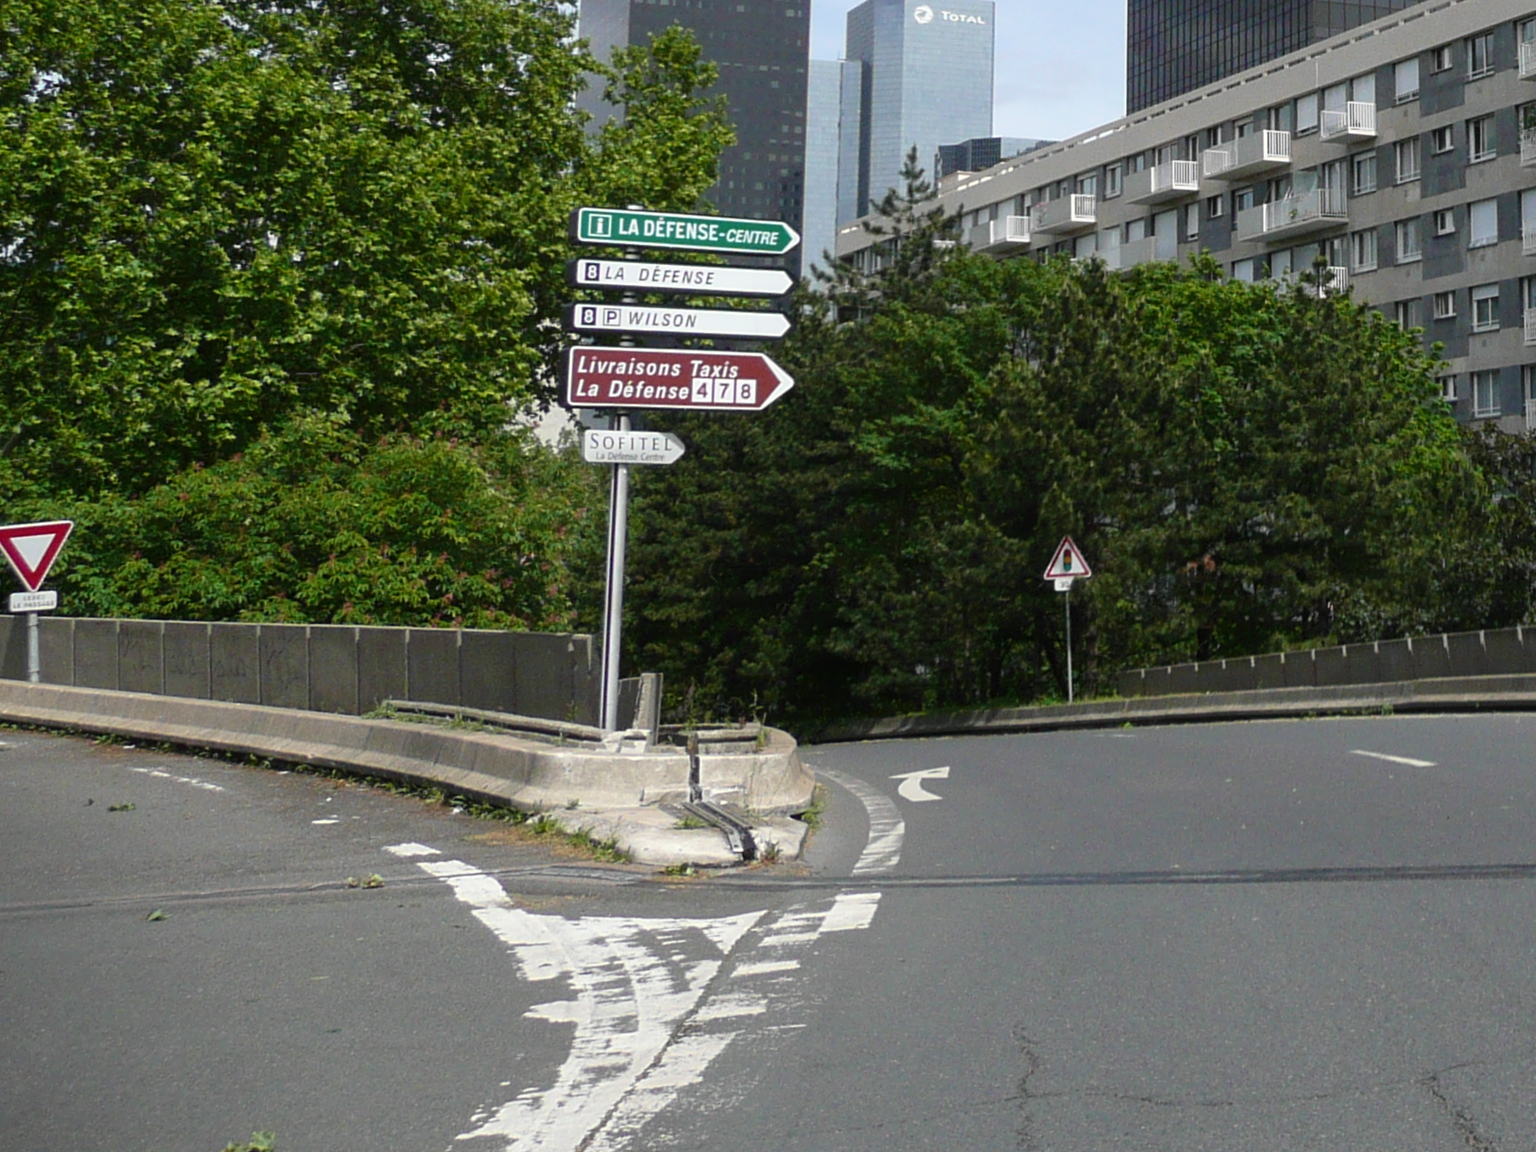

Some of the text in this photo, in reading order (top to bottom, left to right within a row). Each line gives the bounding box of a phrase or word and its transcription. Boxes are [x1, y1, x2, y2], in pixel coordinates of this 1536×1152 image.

[941, 10, 986, 25] TOTAL
[618, 218, 639, 236] LA
[586, 264, 715, 285] 8 LA DÉFENSE
[583, 309, 698, 328] 8 P WILSON
[577, 356, 740, 378] Livraisons Taxis
[576, 379, 599, 397] La
[608, 380, 690, 399] Défense
[590, 432, 672, 451] SOFITEL
[596, 452, 605, 460] La
[640, 452, 664, 461] Centre
